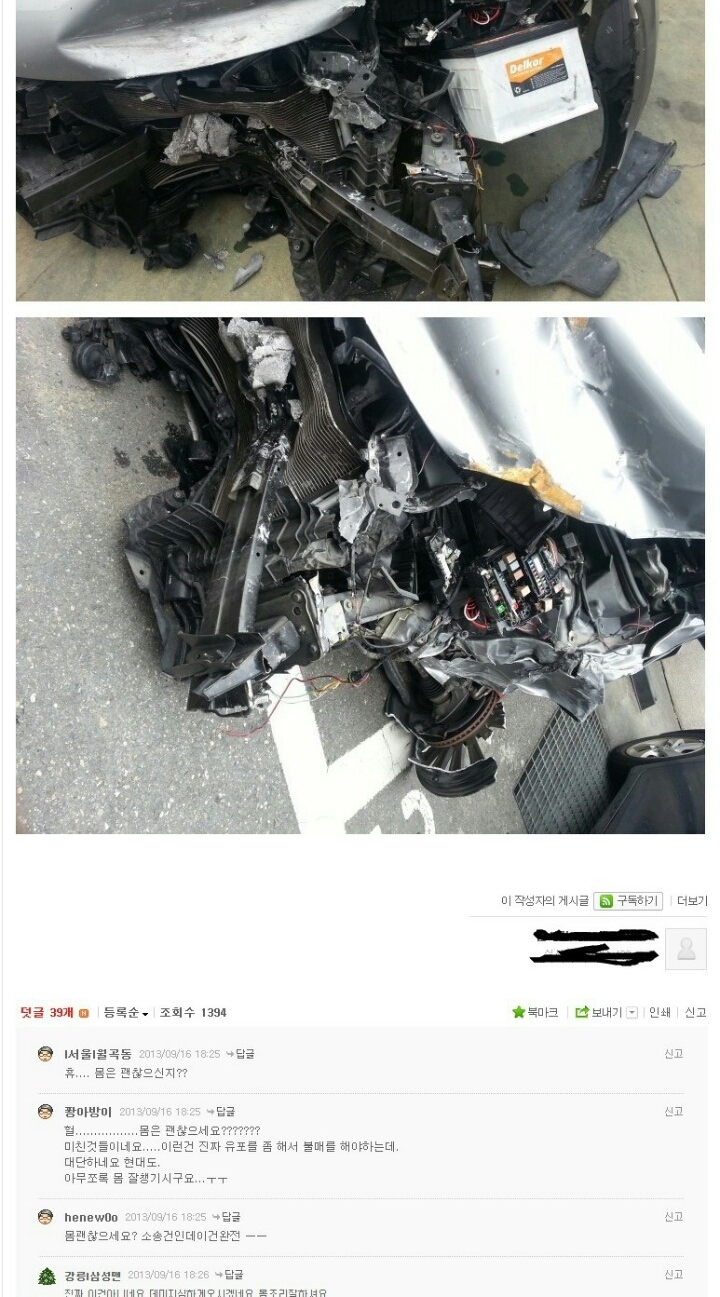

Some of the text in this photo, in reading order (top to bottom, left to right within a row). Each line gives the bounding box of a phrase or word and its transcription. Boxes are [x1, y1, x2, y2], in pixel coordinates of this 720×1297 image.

[509, 57, 545, 75] Delkor
[501, 895, 589, 906] 이 작성자의 게시글
[617, 895, 658, 906] 구독하기
[677, 895, 708, 906] 더보기
[49, 1007, 74, 1019] 39개
[103, 1007, 139, 1019] 등록순
[159, 1007, 227, 1019] 조회수 1394
[527, 1007, 558, 1018] 북마크
[592, 1007, 622, 1018] 보내기
[649, 1007, 671, 1018] 인쇄
[684, 1007, 707, 1018] 신고
[140, 1049, 221, 1060] 2013/09/16 18:25
[235, 1048, 256, 1059] 답글
[664, 1048, 683, 1059] 신고
[64, 1067, 188, 1078] 휴.... 몸은 괜찮으신지??
[120, 1107, 201, 1117] 2013/09/16 18:25
[216, 1106, 236, 1117] 답글
[664, 1106, 683, 1117] 신고
[198, 1140, 221, 1152] 진짜
[224, 1140, 257, 1152] 유포를
[261, 1140, 272, 1152] 좀
[276, 1140, 297, 1152] 해서
[302, 1140, 336, 1152] 불매를
[339, 1140, 398, 1152] 해야하는데.
[64, 1156, 160, 1168] 대단하네요 현대도.
[64, 1172, 108, 1184] 아무쪼록
[113, 1172, 123, 1184] 몸
[126, 1212, 207, 1223] 2013/09/16 18:25
[221, 1211, 242, 1222] 답글
[664, 1211, 683, 1222] 신고
[64, 1230, 137, 1241] 몸괜찮으세요?
[140, 1230, 240, 1241] 소송건인데이건완전
[128, 1270, 210, 1280] 2013/09/16 18:26
[223, 1269, 244, 1280] 답글
[664, 1269, 683, 1280] 신고
